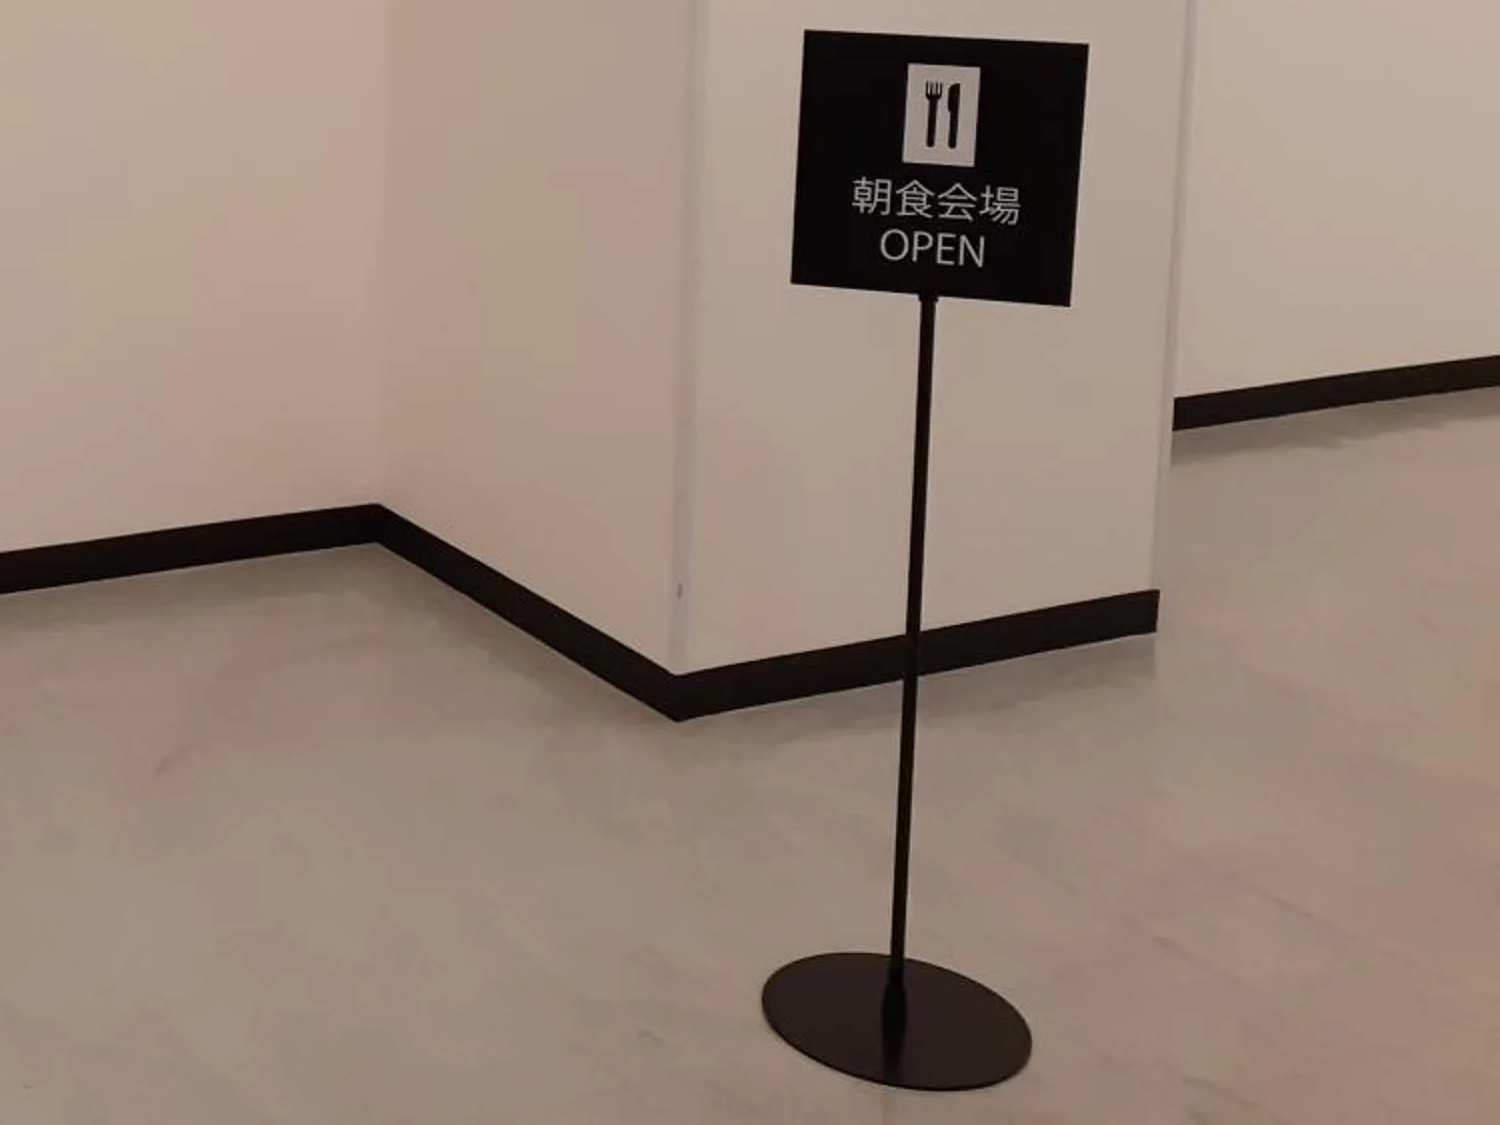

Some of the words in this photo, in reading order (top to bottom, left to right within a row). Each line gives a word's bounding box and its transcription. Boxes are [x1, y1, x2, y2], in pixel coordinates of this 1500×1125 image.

[851, 176, 1020, 225] 朝食会場
[880, 228, 985, 268] OPEN
